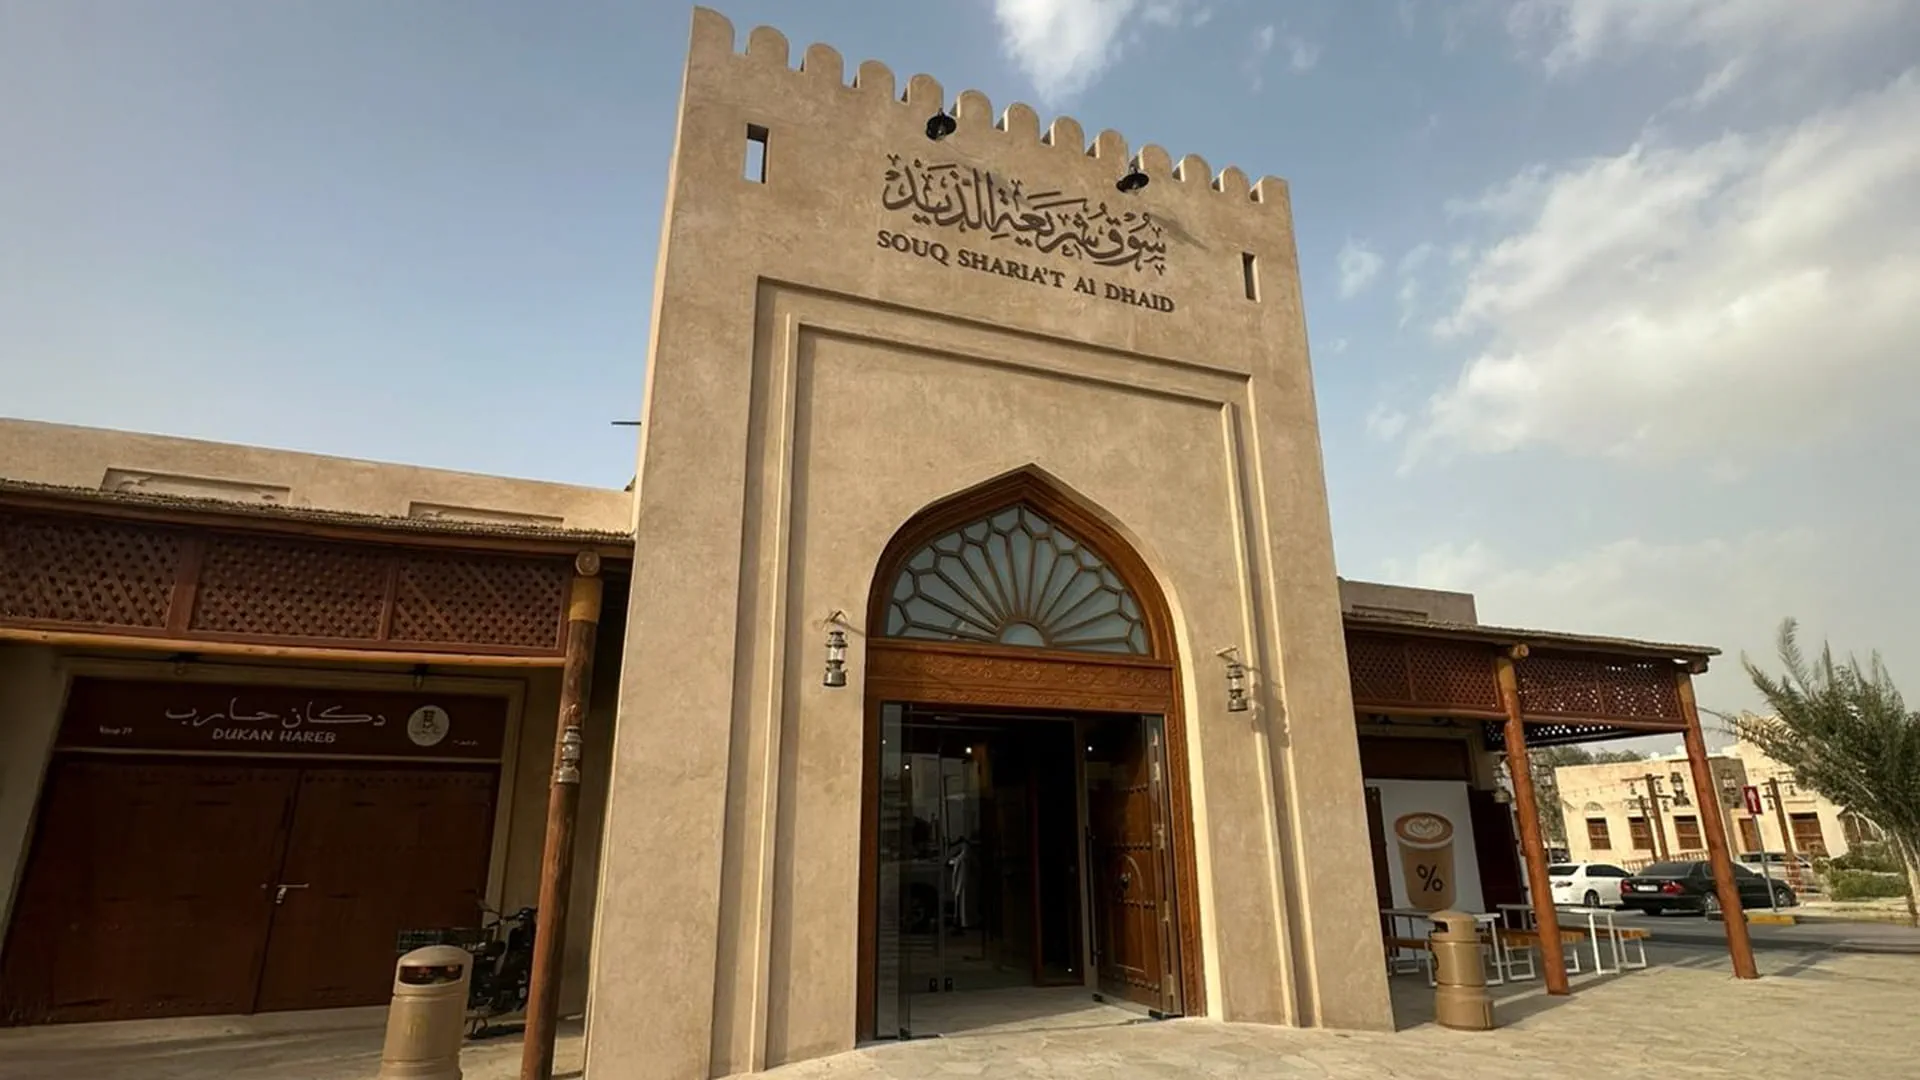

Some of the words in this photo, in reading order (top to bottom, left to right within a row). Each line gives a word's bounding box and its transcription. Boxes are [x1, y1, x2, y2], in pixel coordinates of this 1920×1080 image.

[984, 180, 1099, 259] شريعة
[1083, 203, 1167, 274] سوق
[877, 230, 949, 266] SOUQ
[957, 249, 1066, 288] SHARIA'T
[1074, 278, 1096, 295] Al
[1104, 282, 1176, 313] DHAID
[165, 696, 280, 727] حارب
[212, 728, 274, 741] DUKAN
[279, 730, 337, 743] HAREB
[281, 700, 387, 728] دكان
